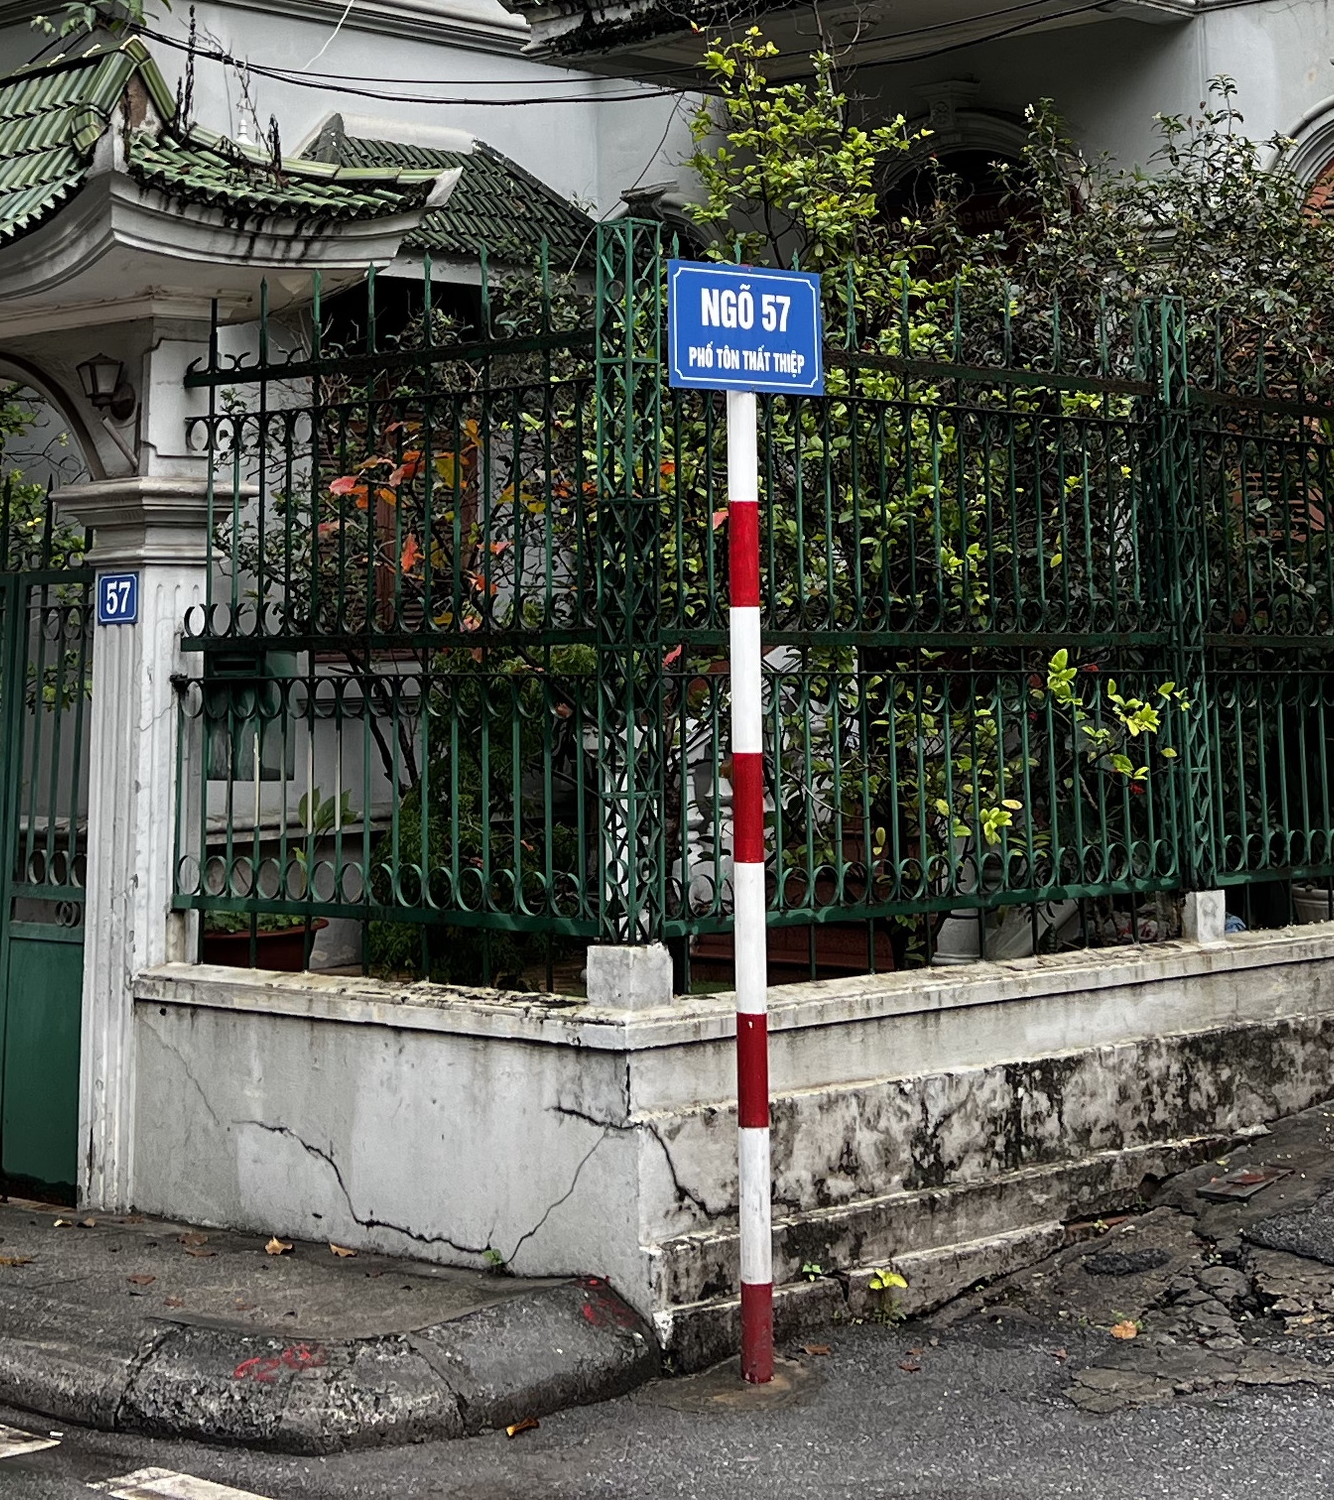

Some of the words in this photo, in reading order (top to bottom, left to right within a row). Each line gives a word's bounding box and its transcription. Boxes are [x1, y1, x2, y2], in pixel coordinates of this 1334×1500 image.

[701, 284, 754, 330] NGÕ
[761, 294, 791, 332] 57
[688, 341, 714, 369] PHỐ
[716, 345, 740, 370] TÔN
[742, 345, 770, 372] THẤT
[773, 350, 805, 378] THIỆP
[106, 581, 131, 614] 57
